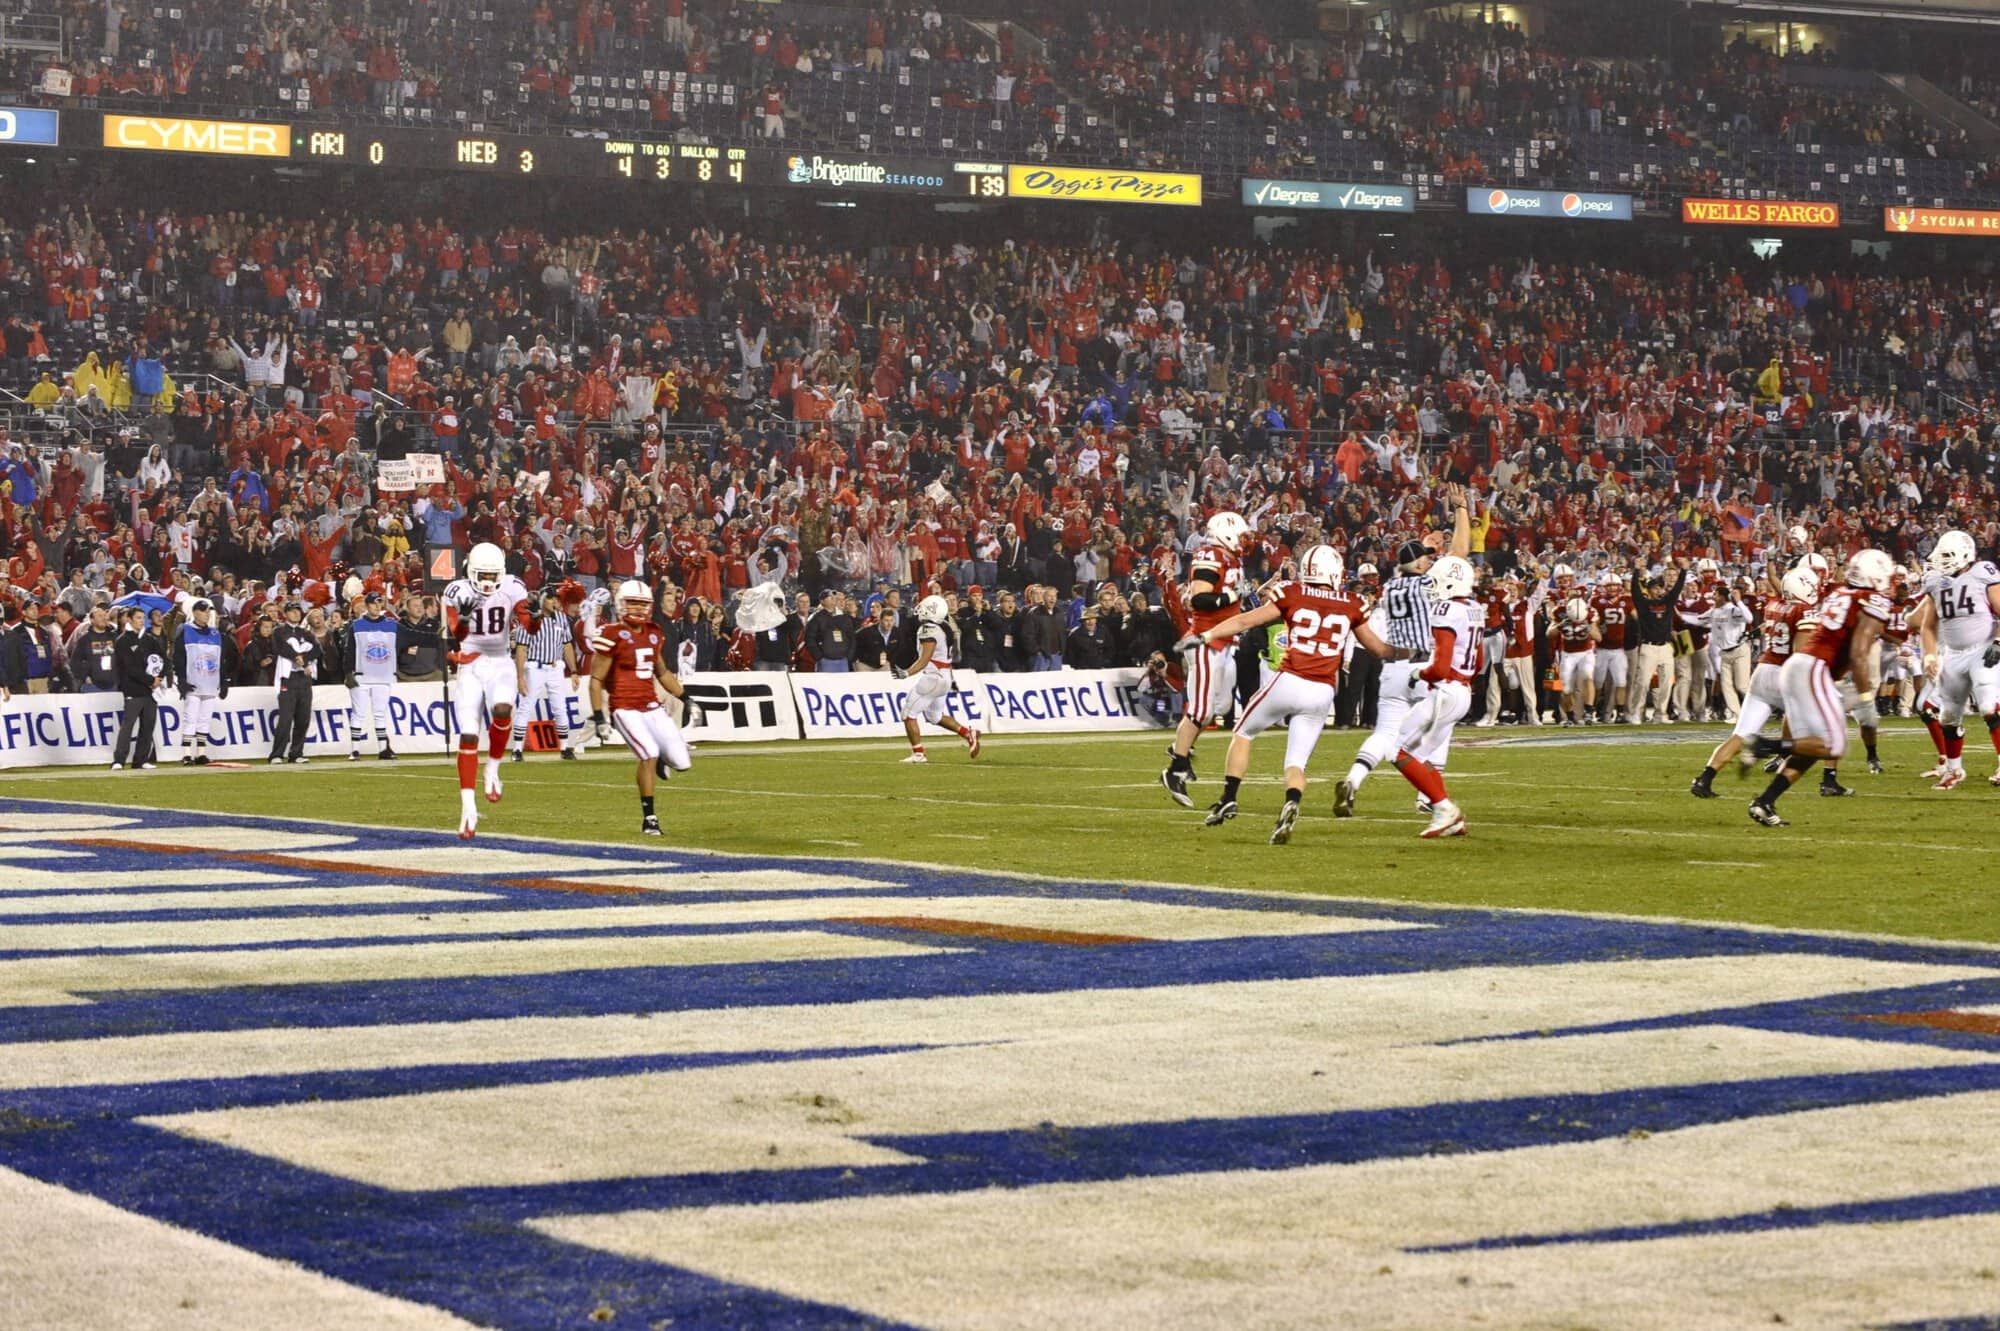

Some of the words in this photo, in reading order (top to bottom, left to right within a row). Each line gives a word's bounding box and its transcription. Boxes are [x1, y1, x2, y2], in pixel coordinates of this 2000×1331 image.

[118, 119, 277, 153] CYMER
[311, 132, 345, 155] ARI
[370, 142, 384, 165] 0
[457, 140, 497, 163] NEB
[605, 142, 635, 154] DOWN
[641, 144, 654, 156] TO
[656, 144, 670, 156] GO
[681, 146, 704, 158] BALL
[705, 147, 719, 159] ON
[728, 149, 746, 160] QTR
[519, 150, 534, 173] 3
[618, 156, 632, 177] 4
[656, 157, 670, 179] 3
[698, 159, 712, 181] 8
[729, 162, 743, 183] 4
[812, 156, 885, 186] Brigantine
[885, 173, 944, 187] SEAFOOD
[1024, 170, 1104, 195] Oggi's
[1108, 175, 1186, 198] Pizza
[1270, 187, 1321, 205] Degree
[1354, 191, 1404, 209] Degree
[1510, 197, 1541, 209] pepsi
[1583, 201, 1614, 212] pepsi
[1686, 202, 1761, 221] WELLS
[1765, 204, 1836, 224] FARGO
[1921, 215, 1976, 228] SYCUAN
[431, 549, 456, 580] 4
[1941, 585, 1976, 619] 64
[471, 606, 506, 635] 18
[1605, 608, 1626, 624] 51
[1290, 608, 1351, 657] 23
[635, 647, 654, 680] 5
[985, 684, 1099, 720] PACIFIC
[1096, 681, 1140, 717] LIF
[0, 711, 60, 750] FIC
[532, 723, 560, 750] 10
